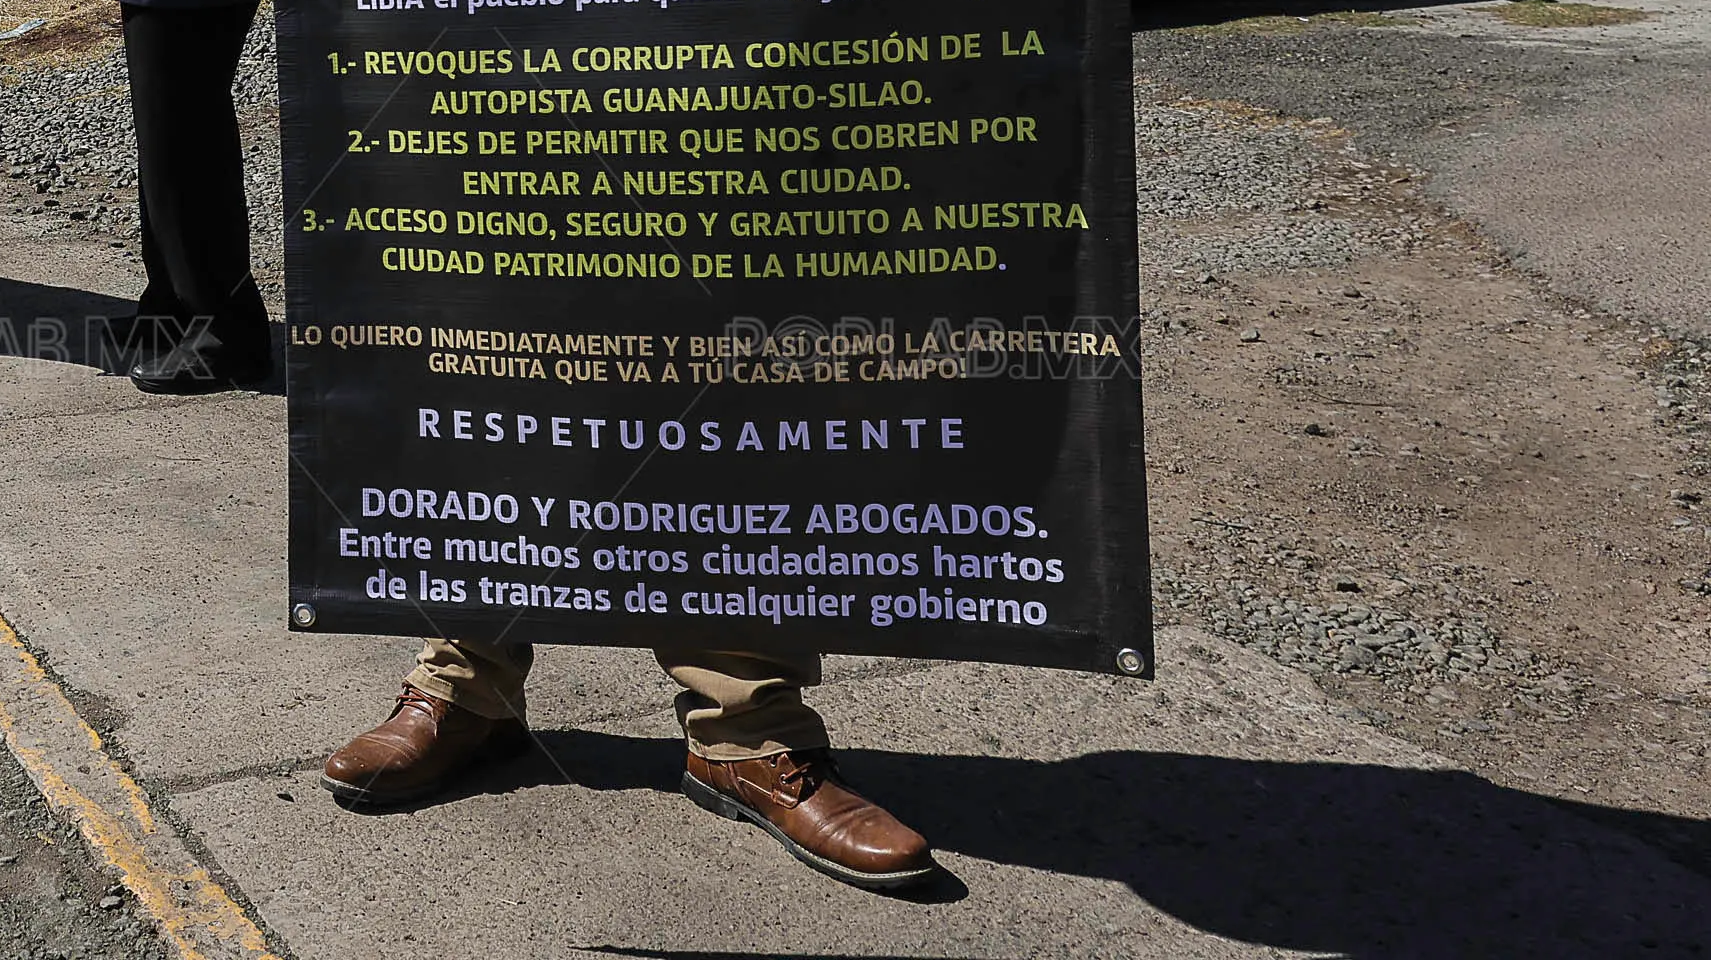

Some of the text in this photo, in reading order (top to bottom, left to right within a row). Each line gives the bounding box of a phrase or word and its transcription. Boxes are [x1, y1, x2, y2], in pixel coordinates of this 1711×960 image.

[328, 31, 1044, 79] 1.- REVOQUES LA CORRUPTA CONCESIÓN DE LA
[431, 80, 931, 114] AUTOPISTA GUANAJUATO-SILAO.
[383, 247, 1006, 277] CIUDAD PATRIMONIO DE LA HUMANIDAD.
[363, 488, 1048, 538] DORADO Y RODRIGUEZ ABOGADOS.
[340, 528, 1064, 582] Entre muchos otros ciudadanos hartos
[366, 569, 1047, 626] de las tranzas de cualquier gobierno
